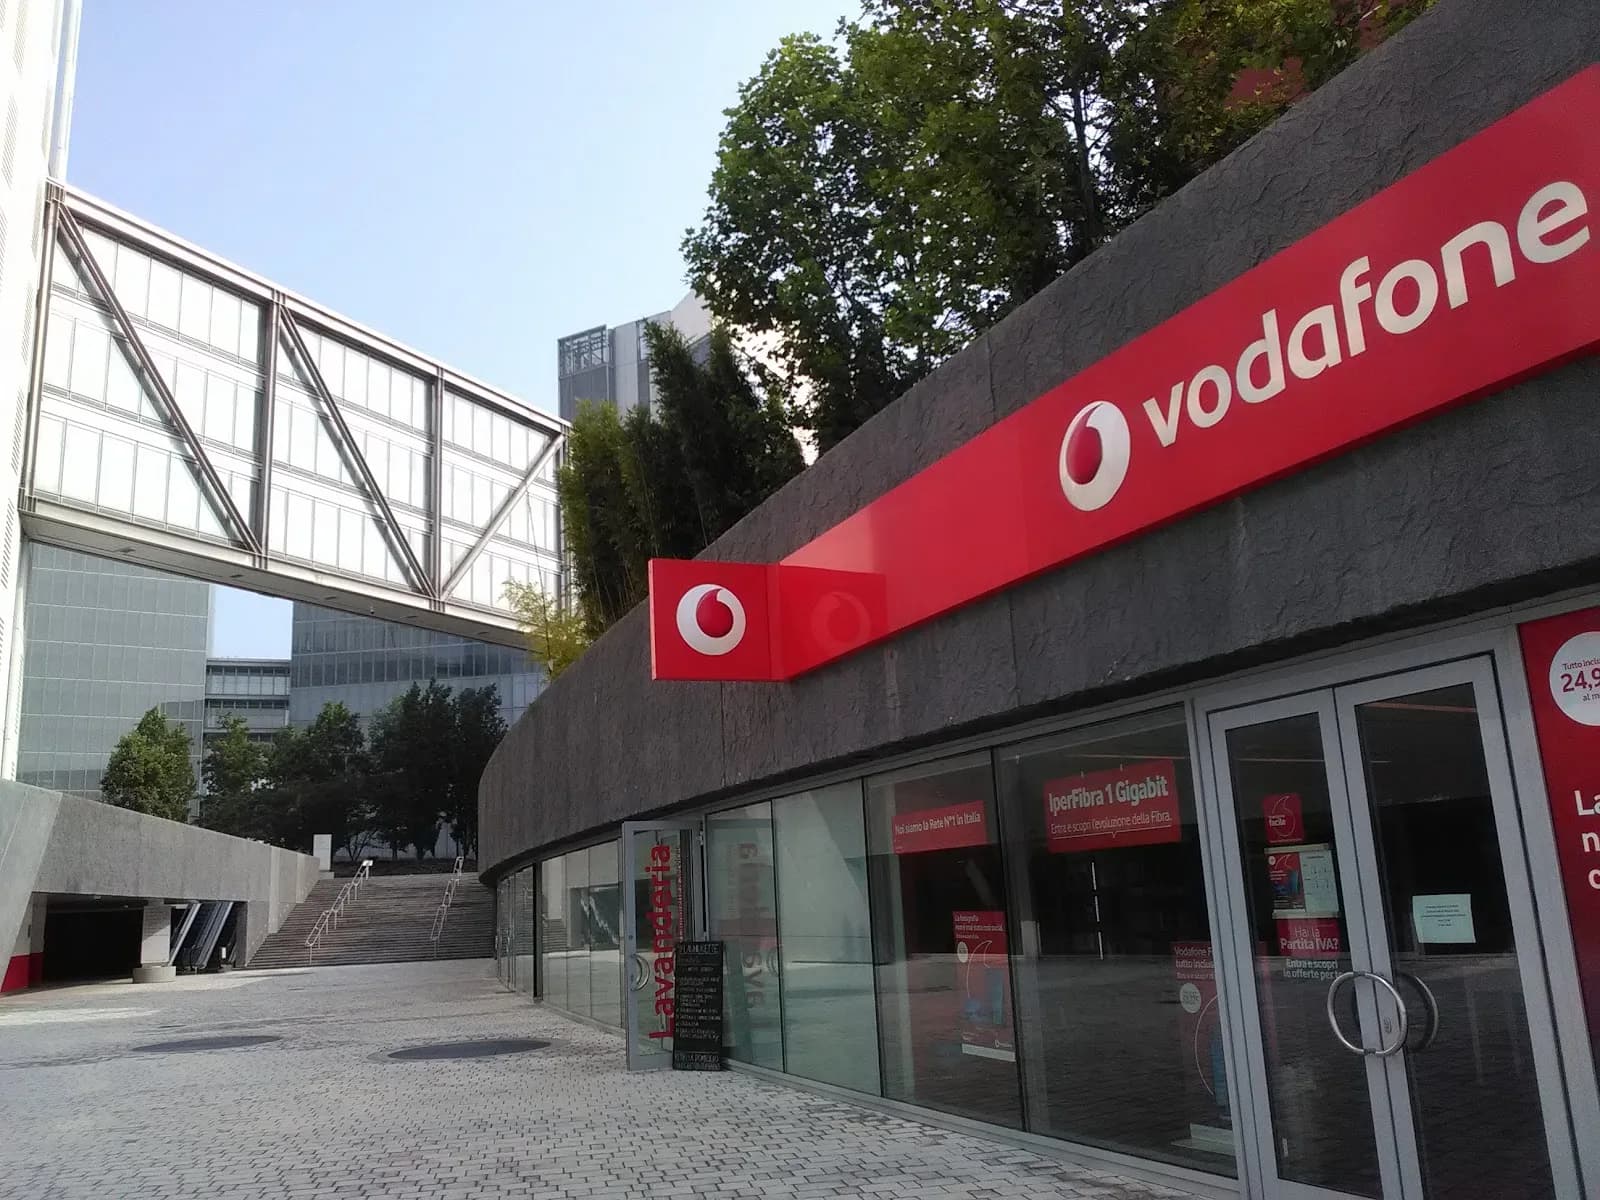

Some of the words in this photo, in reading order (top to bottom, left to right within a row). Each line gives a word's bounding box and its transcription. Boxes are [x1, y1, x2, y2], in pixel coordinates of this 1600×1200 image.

[1142, 181, 1590, 448] vodafone
[1562, 662, 1582, 670] Tutto
[1582, 693, 1590, 701] al
[1048, 787, 1104, 816] IperFibra
[1105, 784, 1113, 803] 1
[1115, 775, 1169, 806] Gigabit
[905, 823, 922, 833] siamo
[922, 820, 929, 831] la
[930, 818, 943, 830] Rete
[956, 814, 964, 825] in
[964, 811, 981, 824] Italia
[1051, 823, 1067, 834] Entra
[1072, 821, 1092, 834] scopri
[1132, 812, 1150, 825] della
[1294, 927, 1309, 937] Hai
[1311, 927, 1321, 938] la
[645, 844, 675, 1039] Lavanderia
[1280, 937, 1314, 950] Partita
[1315, 937, 1339, 950] IVA?
[1175, 946, 1206, 957] Vodafone
[1286, 958, 1306, 968] Entra
[1313, 959, 1339, 970] scopri
[1291, 968, 1319, 978] offerte
